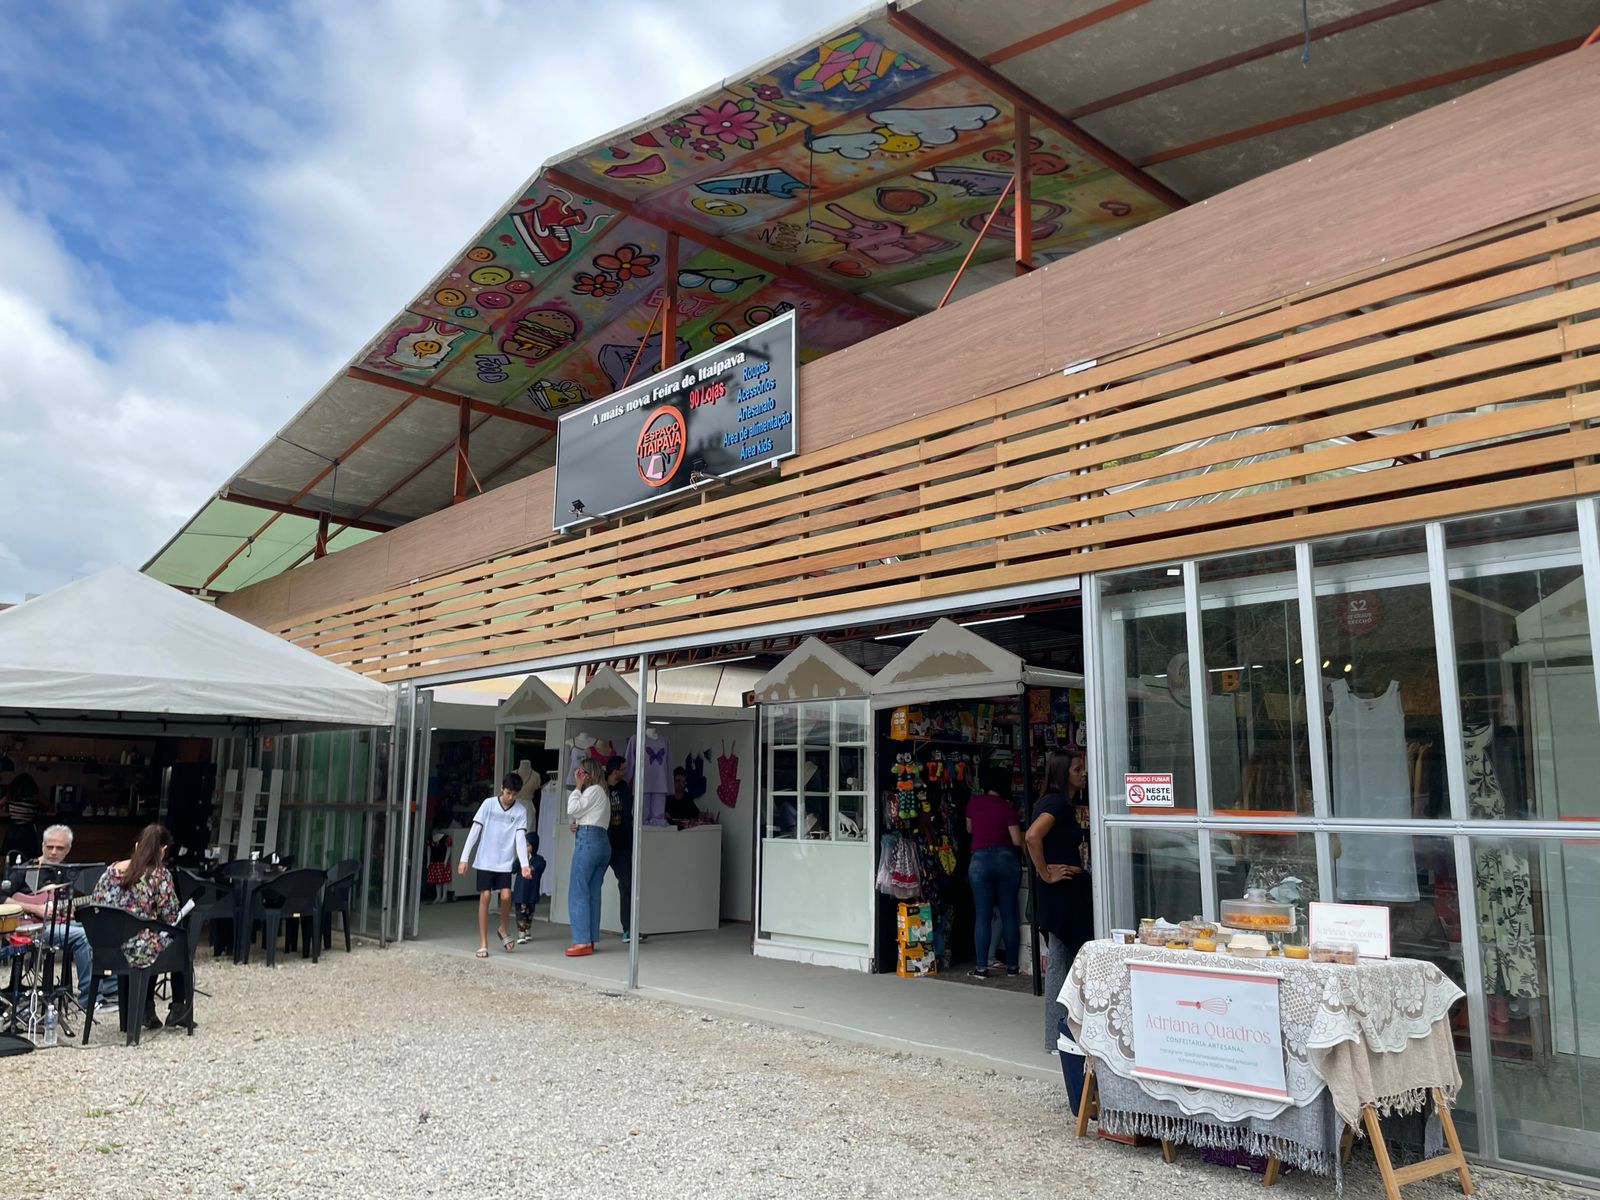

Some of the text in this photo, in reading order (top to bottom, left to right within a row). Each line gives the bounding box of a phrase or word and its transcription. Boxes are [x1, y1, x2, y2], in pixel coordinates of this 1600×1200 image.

[742, 361, 770, 381] Roupas
[591, 352, 746, 426] A mais nova Feira de Itaipava
[689, 381, 725, 409] 90 Lojas
[737, 397, 776, 422] Artesanato
[739, 426, 749, 441] de
[748, 410, 792, 438] alimentação
[639, 432, 682, 458] ITAIPAVA
[756, 437, 773, 454] kids
[1145, 1013, 1272, 1045] Adriana Quadros
[1166, 1036, 1245, 1053] CONFEITARIA ARTESANAL
